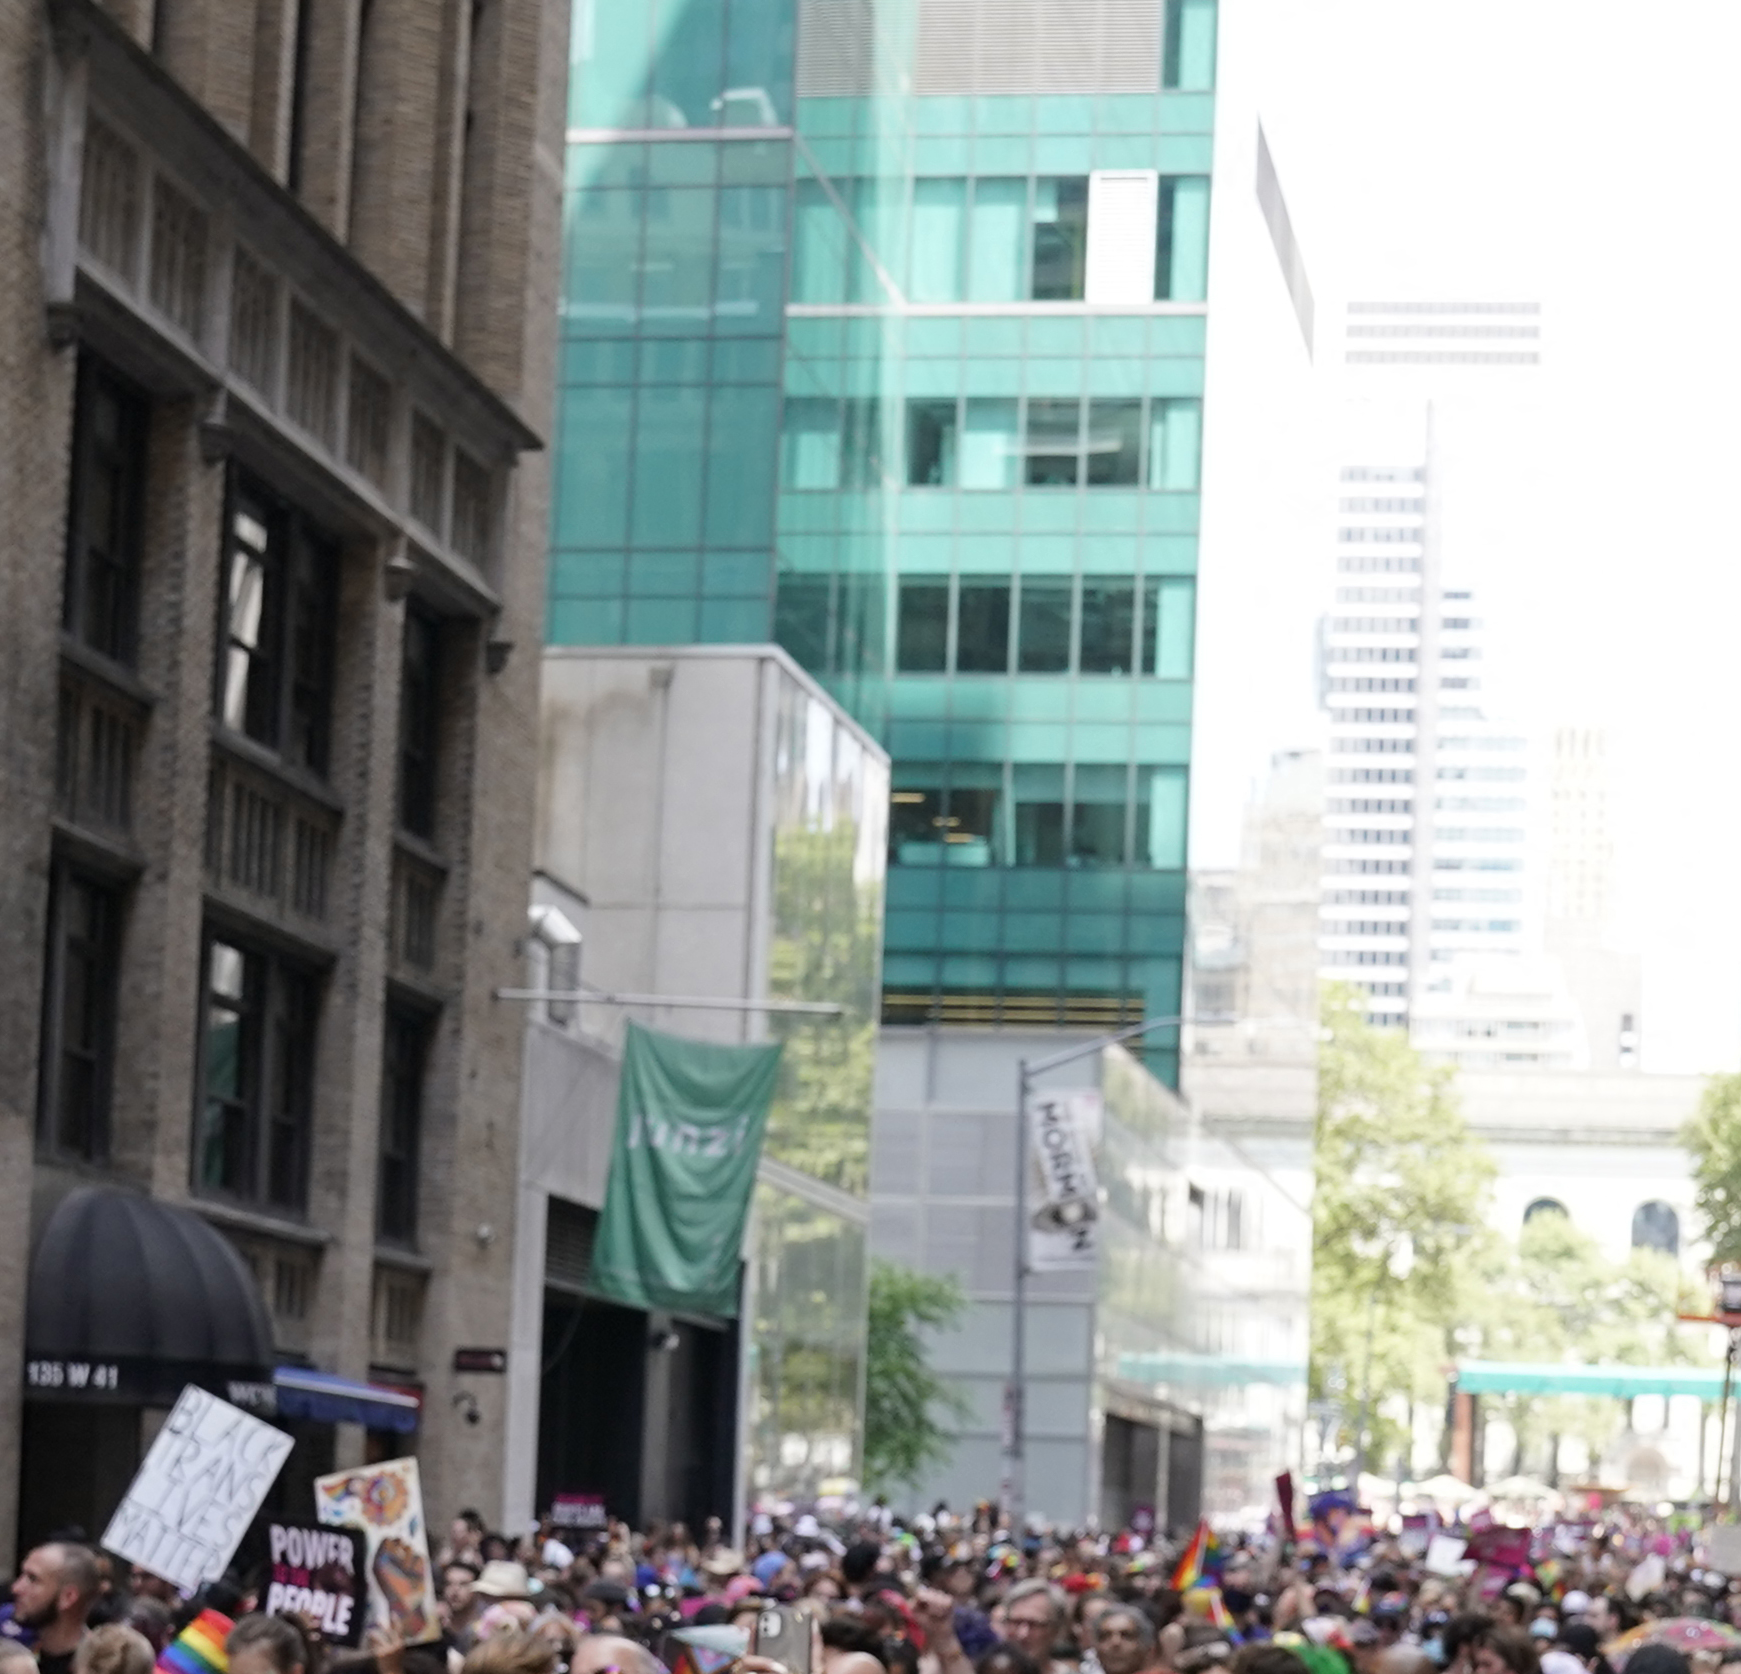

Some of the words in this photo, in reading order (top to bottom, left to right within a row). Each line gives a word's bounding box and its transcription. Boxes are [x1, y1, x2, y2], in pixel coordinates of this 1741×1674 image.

[27, 1360, 64, 1388] 135
[66, 1361, 90, 1389] W
[92, 1364, 119, 1391] 41
[270, 1523, 355, 1576] POWER
[266, 1581, 355, 1636] PEOPLE
